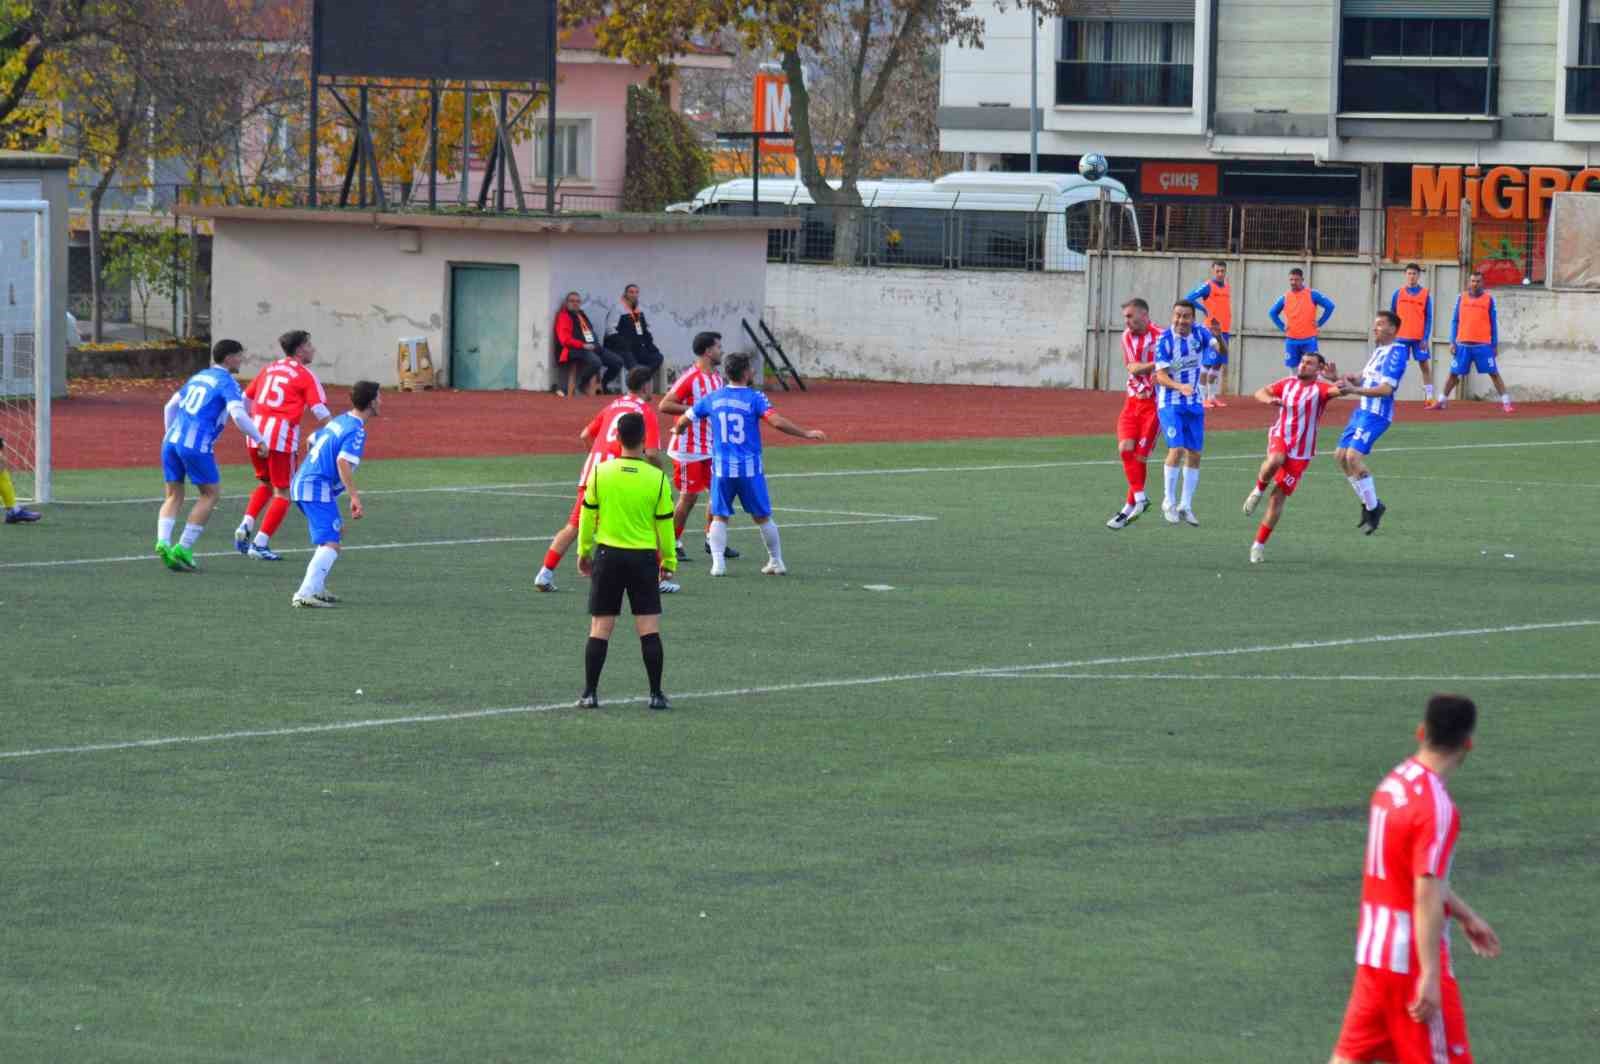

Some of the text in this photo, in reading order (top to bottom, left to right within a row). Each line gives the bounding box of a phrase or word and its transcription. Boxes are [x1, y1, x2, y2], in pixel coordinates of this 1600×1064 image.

[1159, 170, 1200, 191] ÇIKIŞ
[258, 374, 289, 408] 15
[718, 411, 745, 445] 13
[1366, 804, 1388, 881] 11
